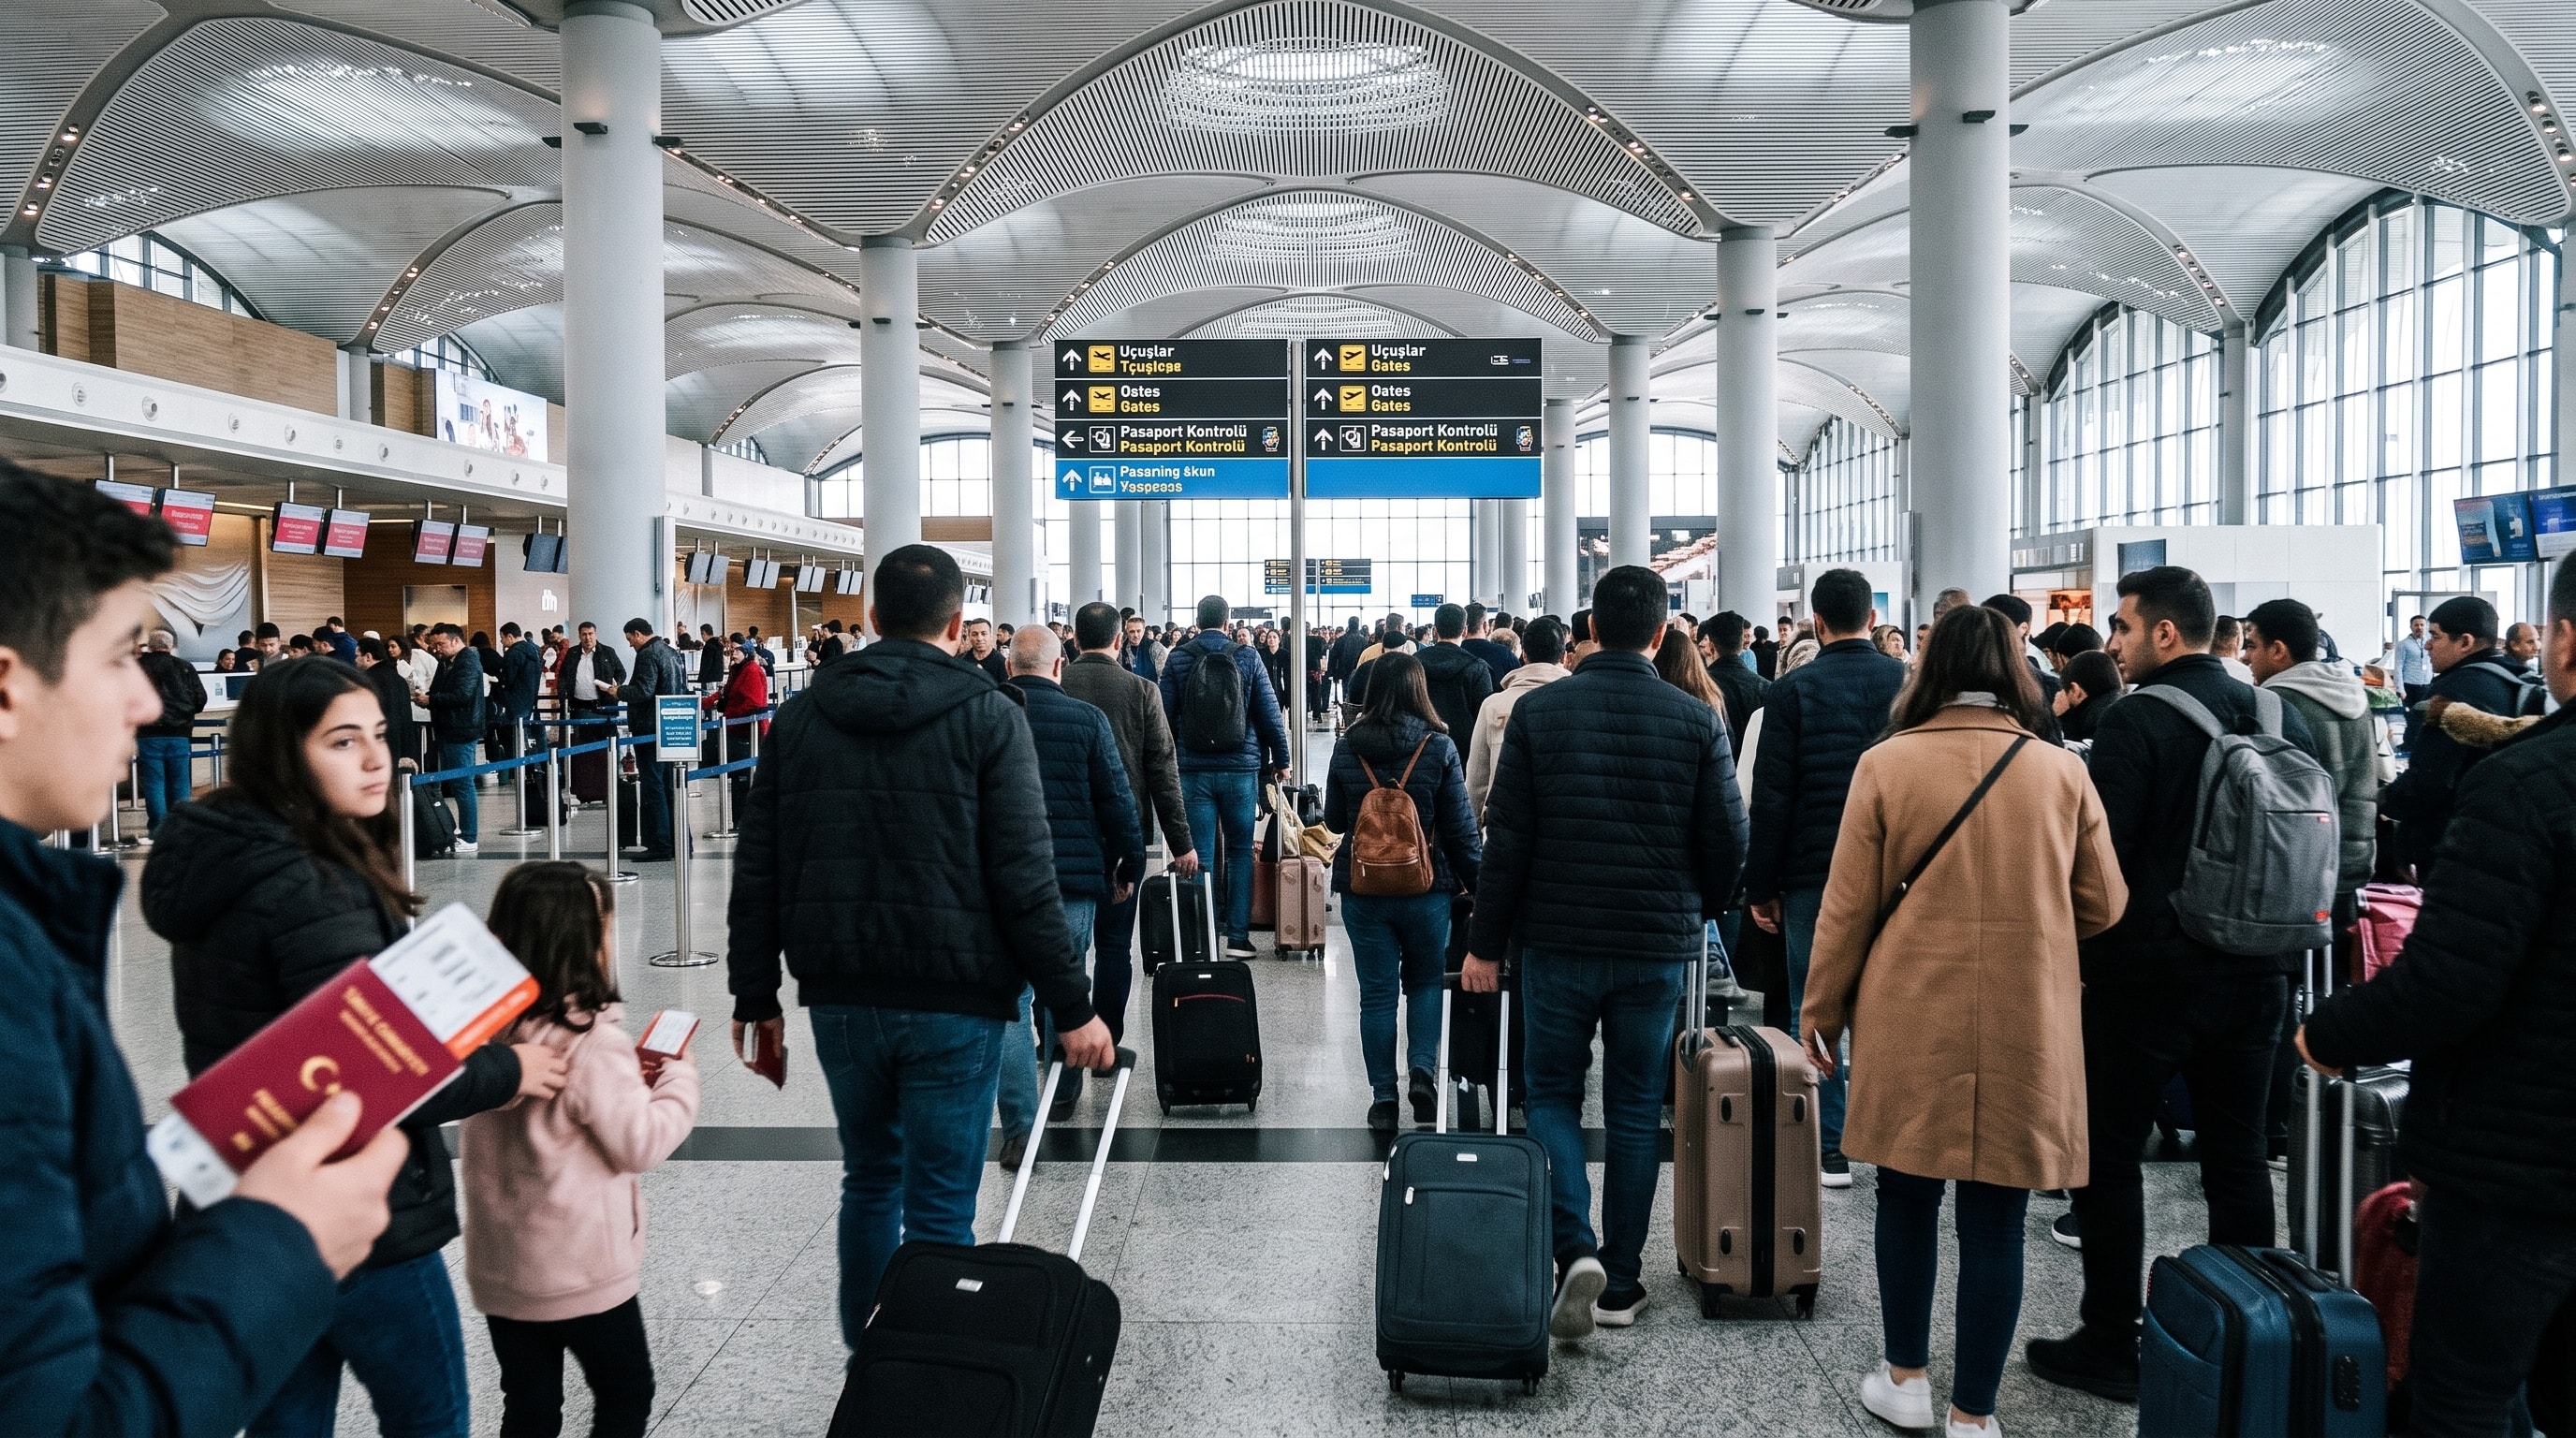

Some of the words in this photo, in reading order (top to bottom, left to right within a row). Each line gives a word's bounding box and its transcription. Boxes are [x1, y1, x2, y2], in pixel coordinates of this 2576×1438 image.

[1120, 345, 1175, 360] Uçuşlar
[1371, 344, 1427, 360] Uçuşlar
[1371, 359, 1412, 372] Gates
[1371, 384, 1412, 397] Oates
[1120, 401, 1161, 413] Gates
[1371, 399, 1412, 412] Gates
[1120, 425, 1182, 443] Pasaport
[1187, 424, 1247, 438] Kontrolü
[1371, 424, 1434, 440] Pasaport
[1437, 423, 1498, 437] Kontrolü
[1120, 440, 1181, 456] Pasaport
[1185, 439, 1245, 453] Kontrolü
[1371, 439, 1433, 455] Pasaport
[1437, 438, 1497, 452] Kontrolü
